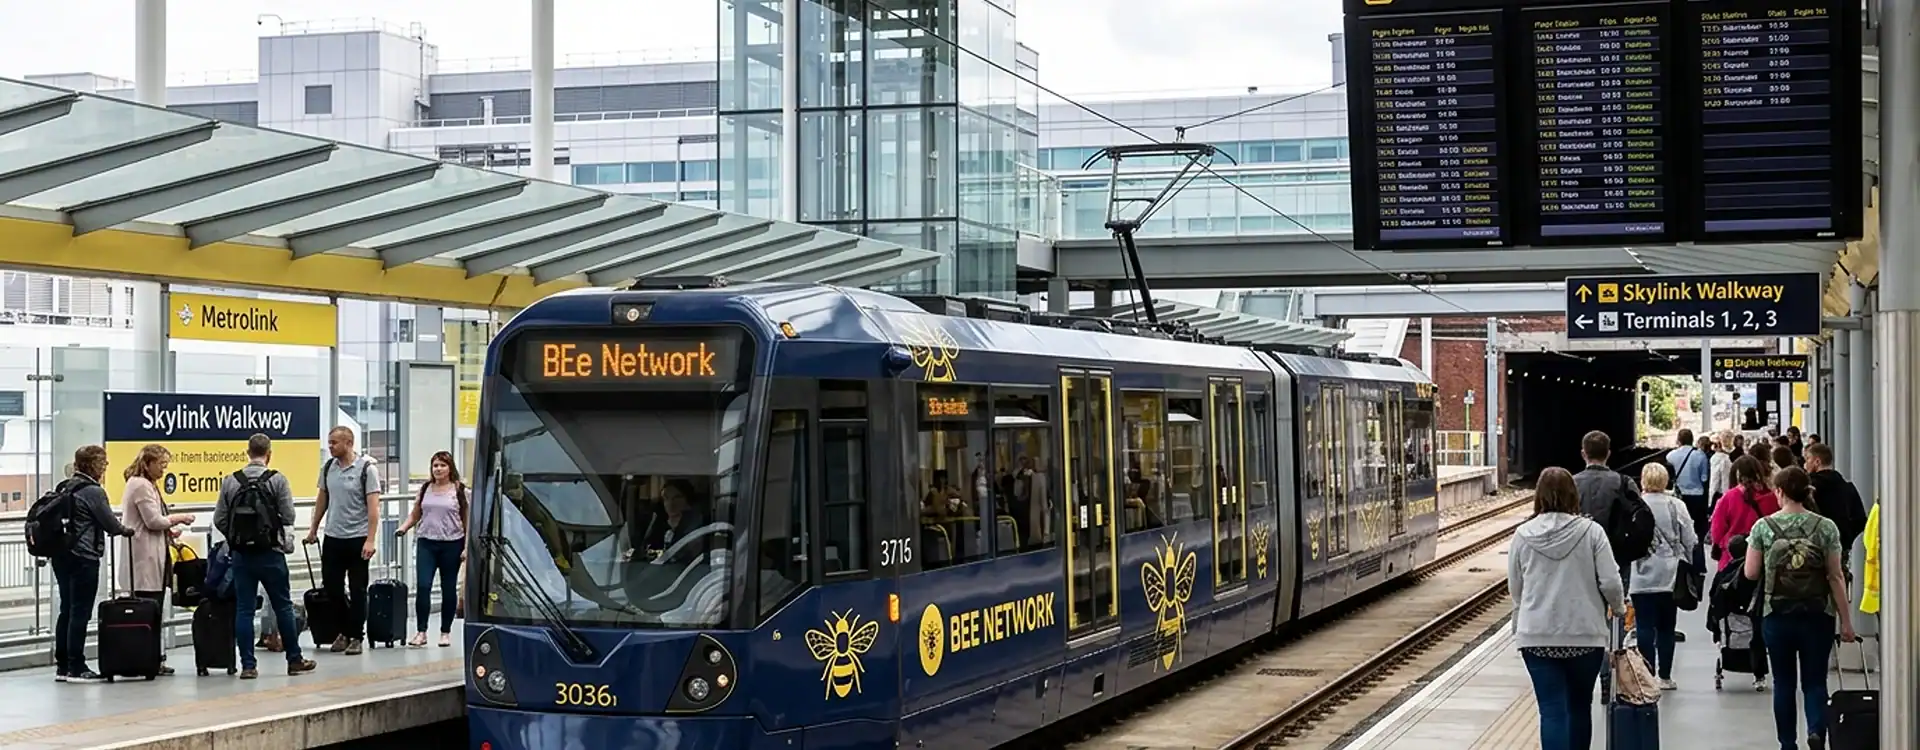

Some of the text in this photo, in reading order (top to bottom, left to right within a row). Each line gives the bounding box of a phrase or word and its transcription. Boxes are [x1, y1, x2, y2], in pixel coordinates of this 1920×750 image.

[1623, 281, 1784, 304] Skylink Walkway
[201, 304, 279, 332] Metrolink
[1623, 310, 1778, 331] Terminals 1, 2, 3
[543, 342, 716, 377] BEe Network
[142, 403, 292, 435] Skylink Walkway
[180, 471, 222, 492] Termi
[950, 591, 1056, 653] BEE NETWORK
